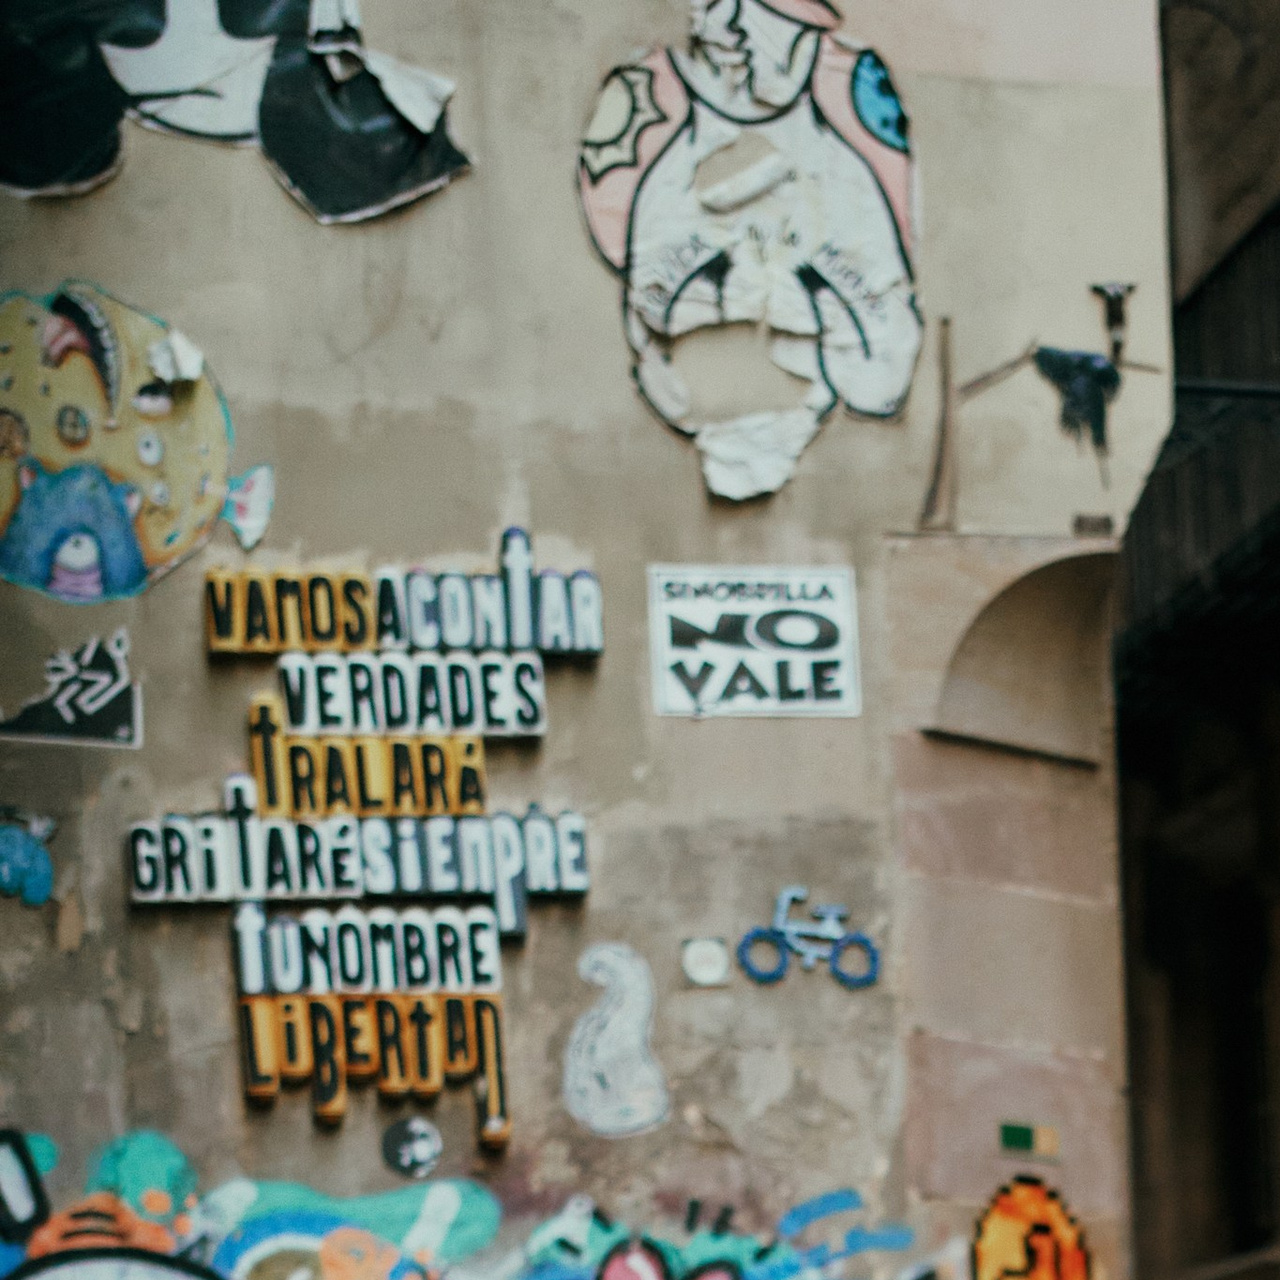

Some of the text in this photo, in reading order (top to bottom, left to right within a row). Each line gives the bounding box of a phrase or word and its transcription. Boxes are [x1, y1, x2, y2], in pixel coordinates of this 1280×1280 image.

[206, 575, 368, 645] VAMOS
[669, 608, 841, 652] NO
[280, 661, 542, 729] VERDADES
[669, 659, 843, 703] VALE
[300, 921, 496, 990] NOMBRE
